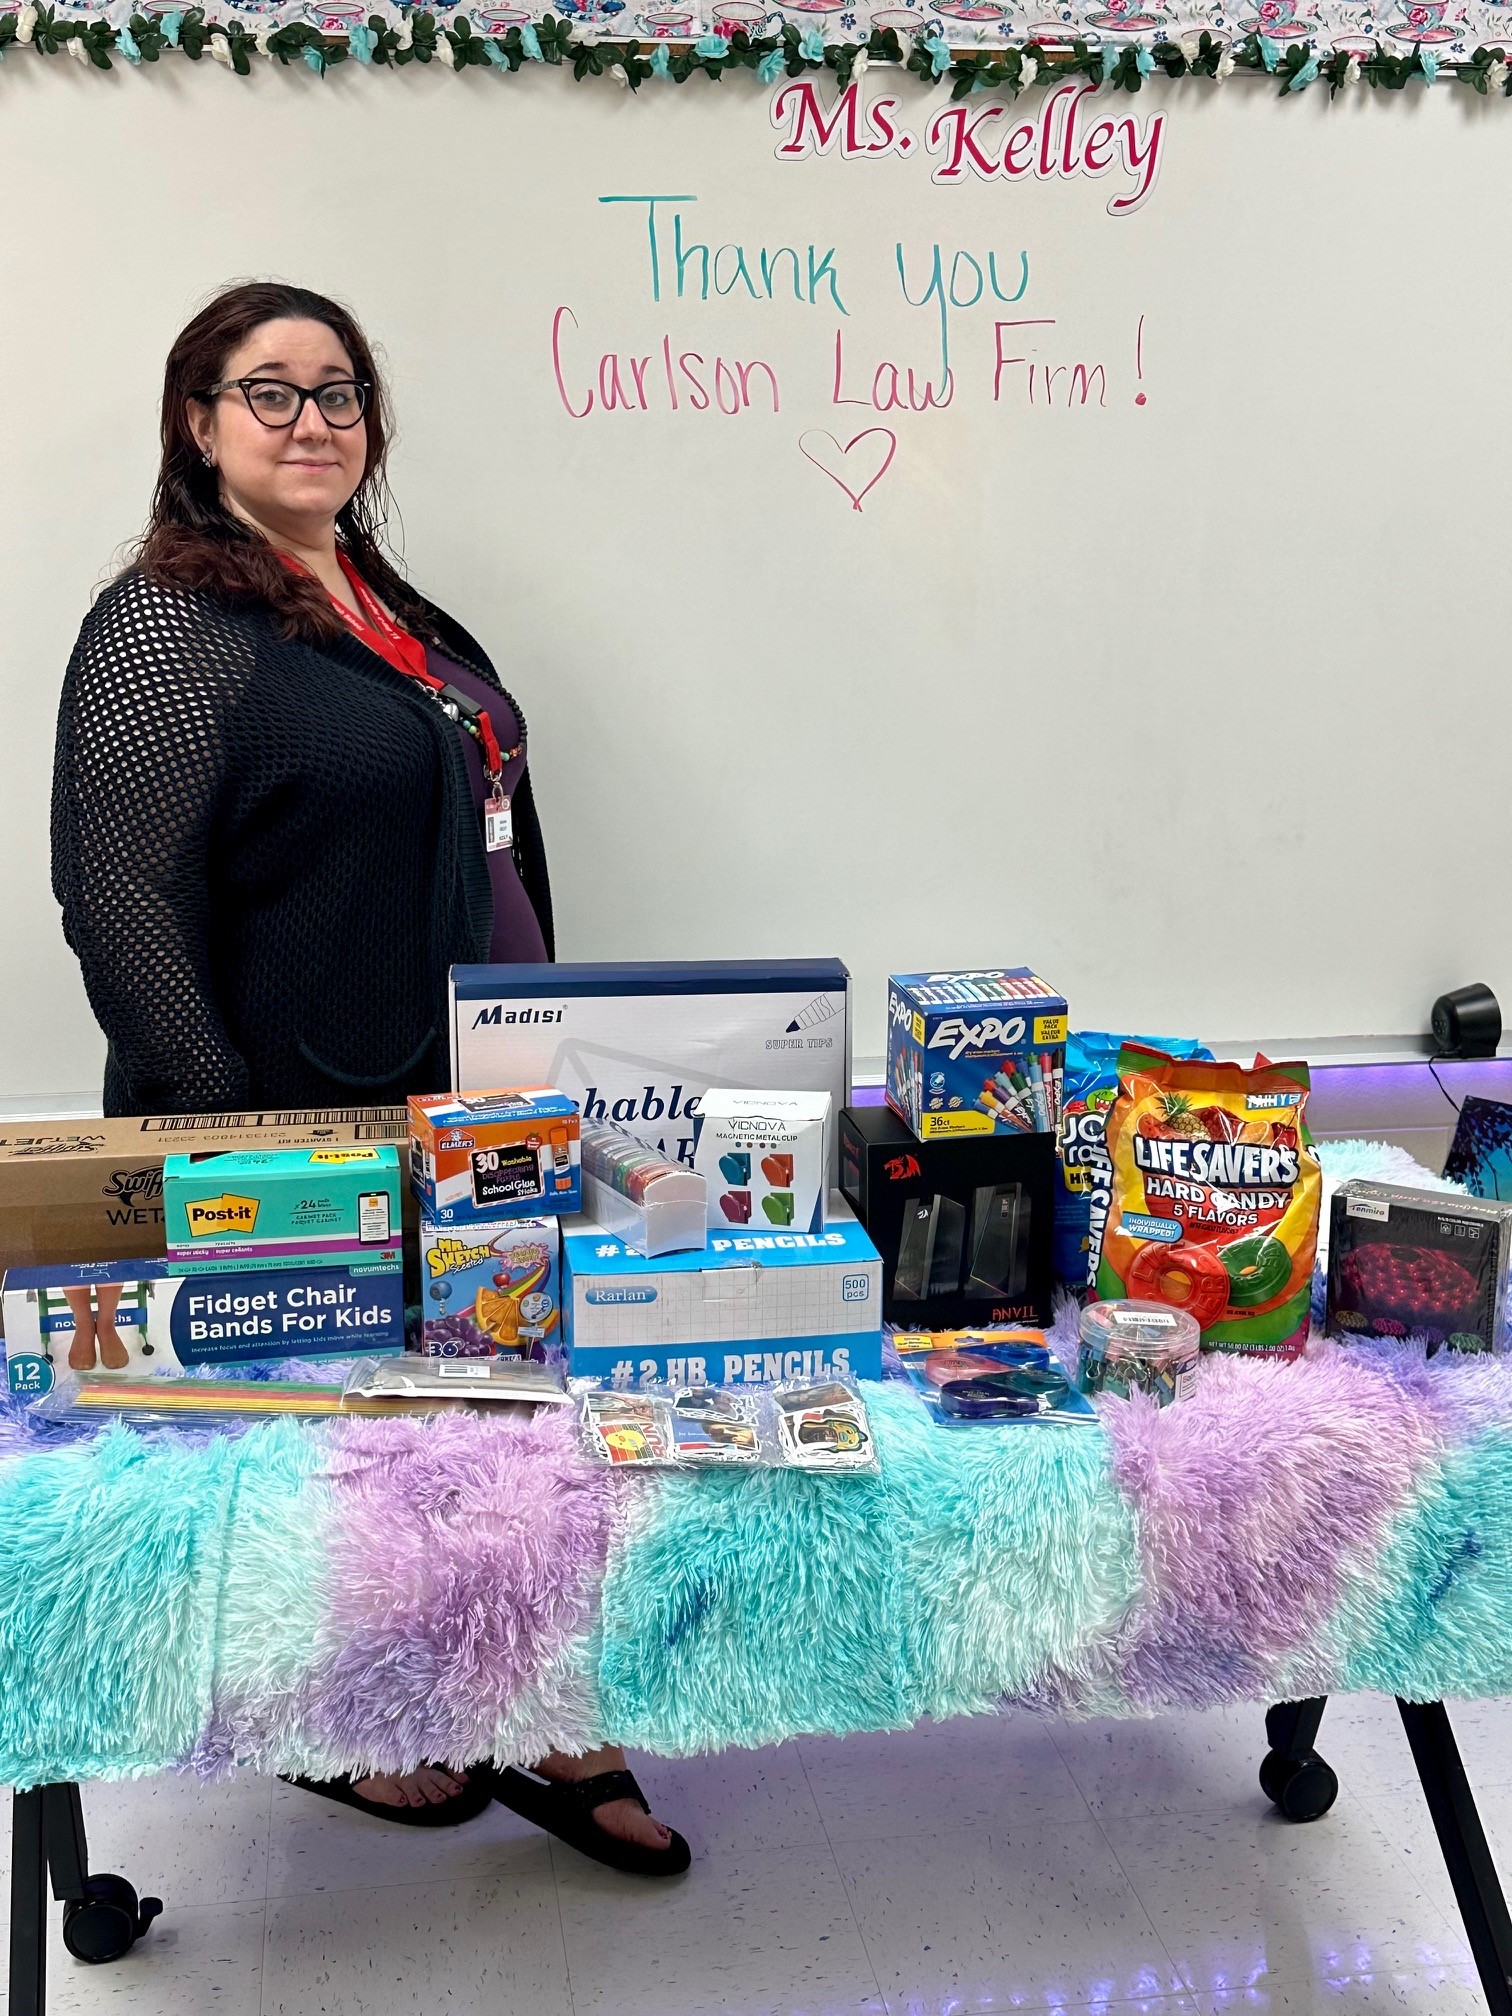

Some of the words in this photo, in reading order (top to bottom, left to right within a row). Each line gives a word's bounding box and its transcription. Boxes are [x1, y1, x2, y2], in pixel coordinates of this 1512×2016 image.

[776, 82, 913, 152] Ms.
[932, 82, 1164, 209] Kelley
[598, 194, 852, 316] Thank
[896, 242, 1030, 402] you
[552, 306, 779, 418] Carlson
[835, 328, 955, 411] Law
[889, 991, 912, 1031] EXPO
[765, 1037, 804, 1050] SUPER
[806, 1037, 833, 1049] TIPS
[927, 1016, 1026, 1060] EXPO
[727, 1119, 787, 1132] VICNOVA
[716, 1132, 755, 1140] MAGNETIC
[756, 1134, 780, 1142] METAL
[315, 1152, 374, 1160] Post-it
[475, 1151, 499, 1174] 30
[1135, 1136, 1190, 1178] LIFE
[1192, 1142, 1299, 1184] SAVERS
[482, 1180, 514, 1196] School
[514, 1179, 536, 1189] Glue
[517, 1188, 539, 1196] Sticks
[1146, 1178, 1206, 1203] HARD
[1210, 1189, 1292, 1211] CANDY
[106, 1208, 164, 1226] WET
[192, 1206, 252, 1222] Post-it
[440, 1209, 454, 1220] 30
[1173, 1204, 1183, 1216] 5
[1188, 1206, 1259, 1226] FLAVORS
[710, 1233, 848, 1252] PENCILS
[380, 1252, 396, 1260] 3M
[426, 1245, 492, 1279] SKETCH
[844, 1278, 867, 1290] 500
[189, 1290, 278, 1316] Fidget
[286, 1284, 357, 1308] Chair
[594, 1287, 648, 1302] Rarlan
[846, 1290, 865, 1299] pcs
[190, 1315, 273, 1341] Bands
[282, 1312, 327, 1333] For
[335, 1305, 393, 1328] Kids
[992, 1305, 1039, 1323] ANVIL
[14, 1362, 41, 1381] 12
[666, 1357, 708, 1385] HB
[723, 1347, 851, 1385] PENCILS
[15, 1380, 41, 1390] Pack
